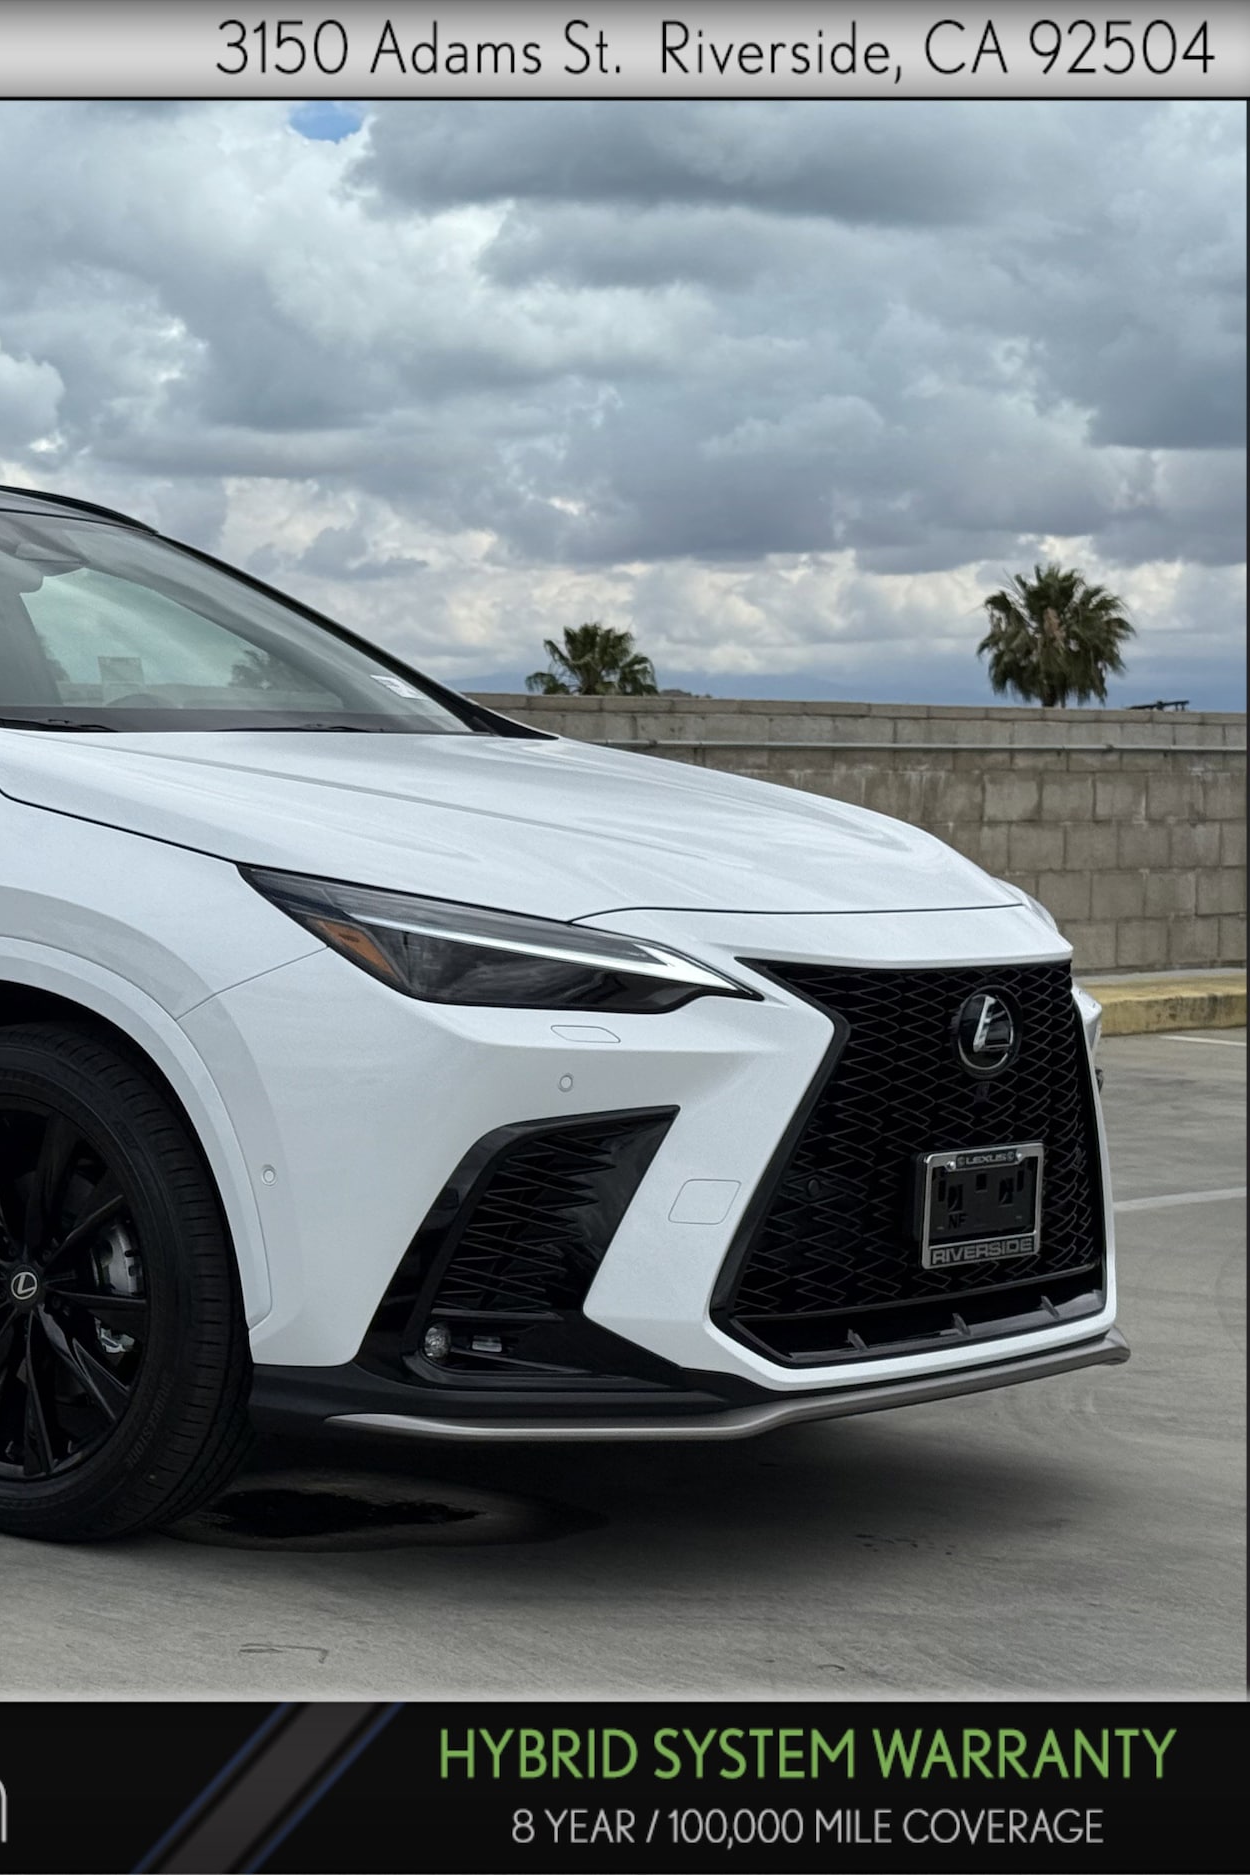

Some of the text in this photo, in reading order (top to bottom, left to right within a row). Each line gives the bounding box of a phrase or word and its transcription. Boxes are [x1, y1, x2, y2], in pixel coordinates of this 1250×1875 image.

[965, 1153, 1007, 1165] LEXUS
[931, 1238, 1033, 1265] RIVERSIDE
[124, 1370, 174, 1470] RIDGESTONE
